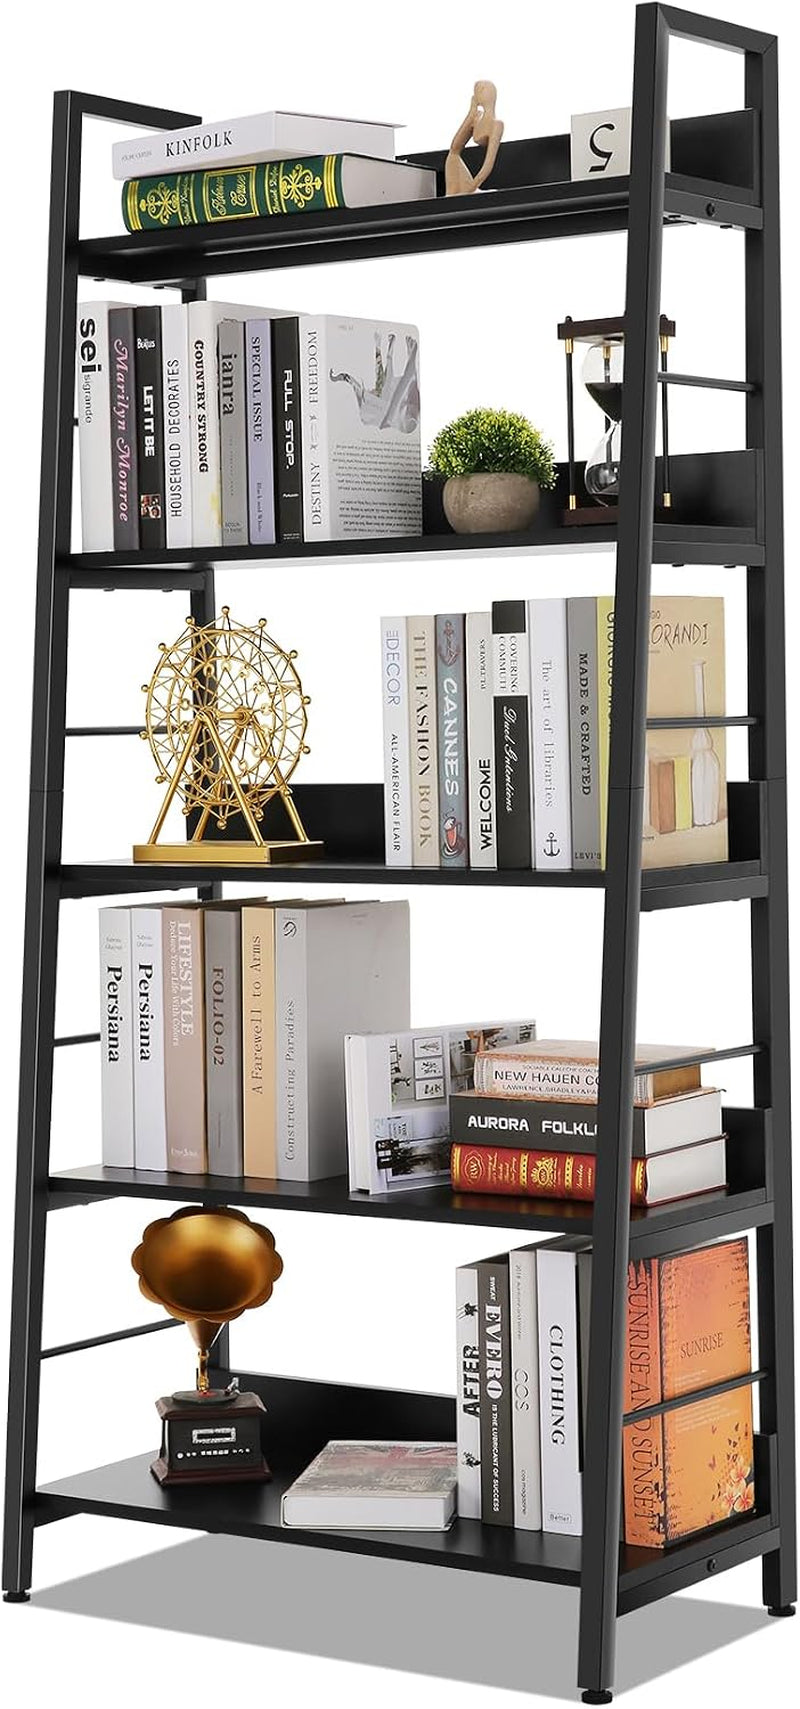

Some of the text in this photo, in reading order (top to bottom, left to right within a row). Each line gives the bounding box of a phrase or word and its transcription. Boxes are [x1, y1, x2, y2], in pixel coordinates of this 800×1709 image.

[166, 130, 233, 157] KINFOLK
[79, 317, 102, 374] sei
[307, 331, 320, 403] FREEDOM
[83, 374, 93, 424] sigrando
[143, 385, 155, 457] LET IT BE
[193, 339, 209, 473] COUNTRY STRONG
[221, 354, 237, 416] ianra
[251, 336, 263, 442] SPECIAL ISSUE
[283, 369, 294, 412] FULL
[113, 338, 131, 522] Marilyn Monroe
[167, 359, 182, 517] HOUSEHOLD DECORATES
[311, 462, 322, 525] DESTINY
[386, 637, 400, 706] DECOR
[413, 630, 428, 678] THE
[509, 635, 519, 693] COVERING
[651, 623, 708, 650] ORANDI
[443, 676, 460, 797] CANNES
[541, 659, 556, 807] The art of libraries
[578, 653, 592, 796] MADE & CRAFTED
[390, 733, 401, 852] ALL-AMERICAN FLAIR
[418, 785, 433, 849] BOOK
[478, 758, 493, 851] WELCOME
[107, 965, 123, 1063] Persiana
[138, 963, 154, 1062] Persiana
[170, 976, 179, 994] Life
[171, 996, 180, 1017] With
[178, 921, 194, 1037] LIFESTYLE
[249, 935, 263, 1095] A Farewell to Arms
[212, 967, 224, 1067] FOLIO-02
[284, 1000, 296, 1161] Constructing Paradies
[494, 1070, 527, 1082] NEW
[467, 1114, 530, 1133] AURORA
[542, 1120, 598, 1137] FOLKL
[489, 1276, 497, 1301] SWEAT
[485, 1303, 503, 1399] EVERO
[628, 1280, 651, 1375] SUNRISE
[680, 1331, 724, 1361] SUNRISE
[462, 1344, 480, 1418] AFTER
[514, 1367, 530, 1412] COS
[549, 1324, 566, 1446] CLOTHING
[631, 1436, 655, 1526] SUNSET
